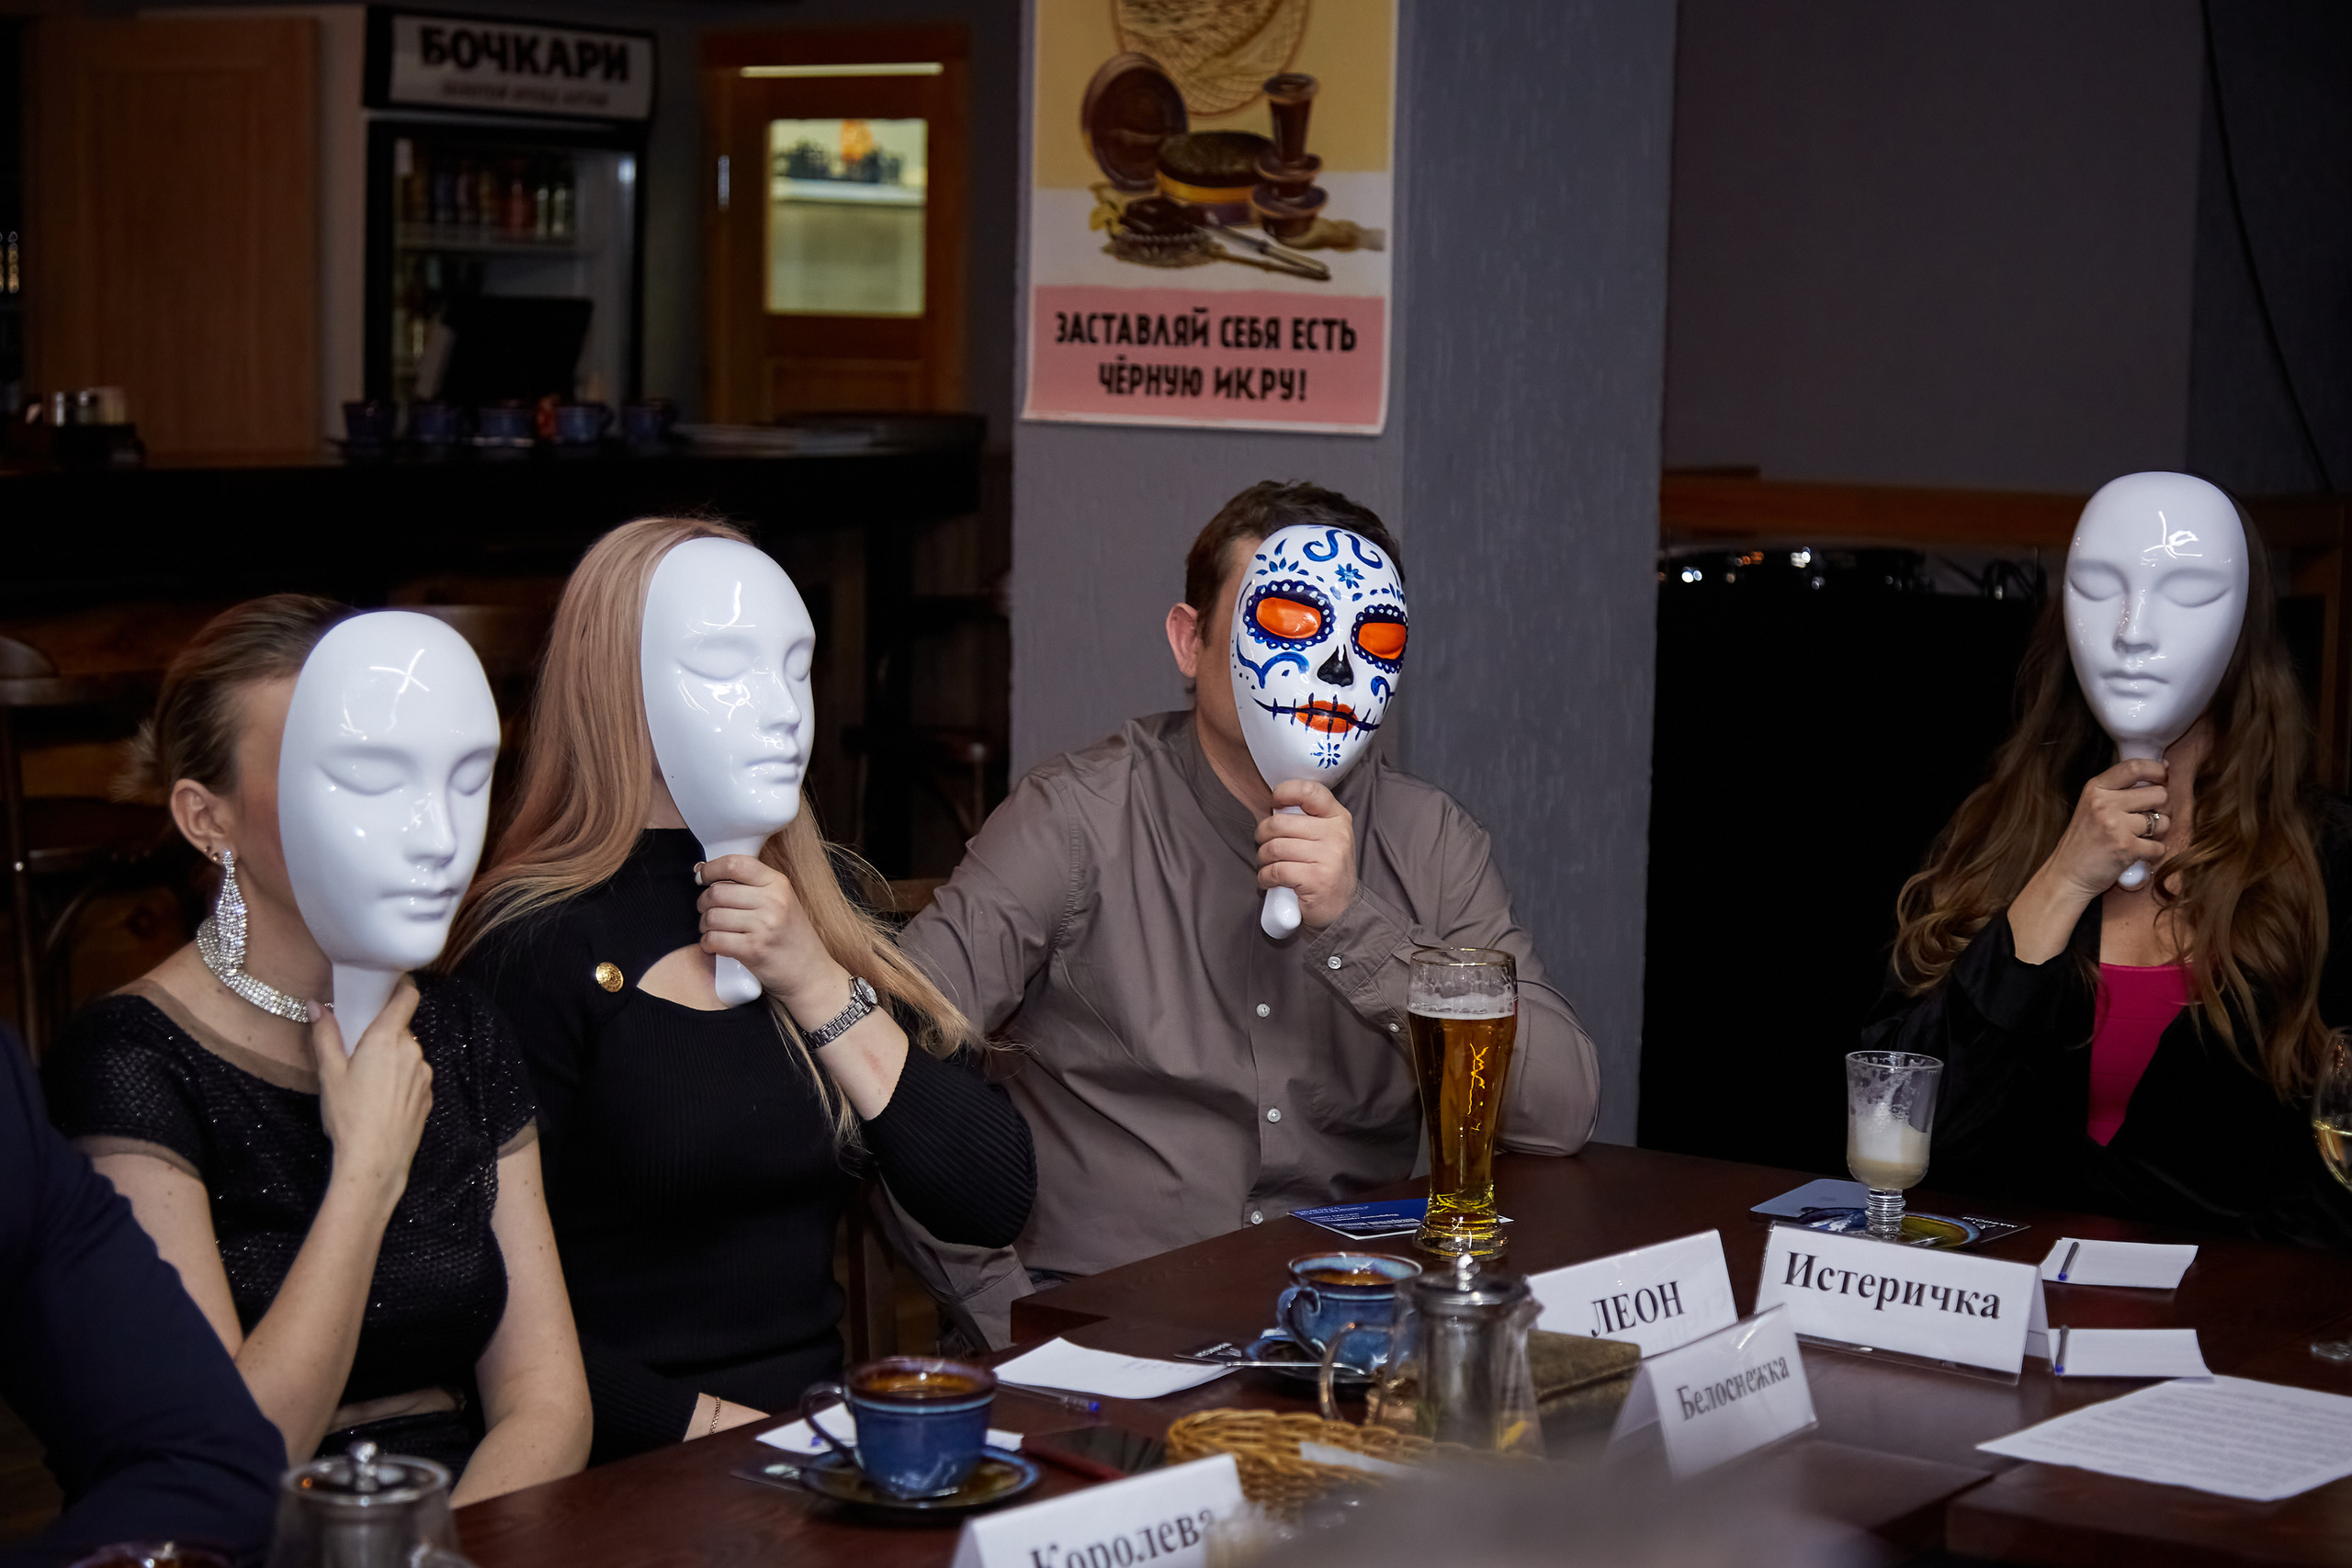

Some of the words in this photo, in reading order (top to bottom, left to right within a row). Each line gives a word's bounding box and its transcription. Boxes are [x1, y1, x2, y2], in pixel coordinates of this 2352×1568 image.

[421, 27, 628, 81] БОЧКАРИ
[1056, 307, 1210, 348] ЗАСТАВЛЯЙ
[1220, 316, 1281, 351] СЕБЯ
[1292, 318, 1357, 352] ЕСТЬ
[1100, 356, 1203, 399] ЧЁРНУЮ
[1214, 367, 1307, 401] ИКРУ!
[1590, 1280, 1684, 1337] ЛЕОН
[1783, 1251, 2001, 1320] Истеричка
[1677, 1356, 1790, 1421] Белоснежка
